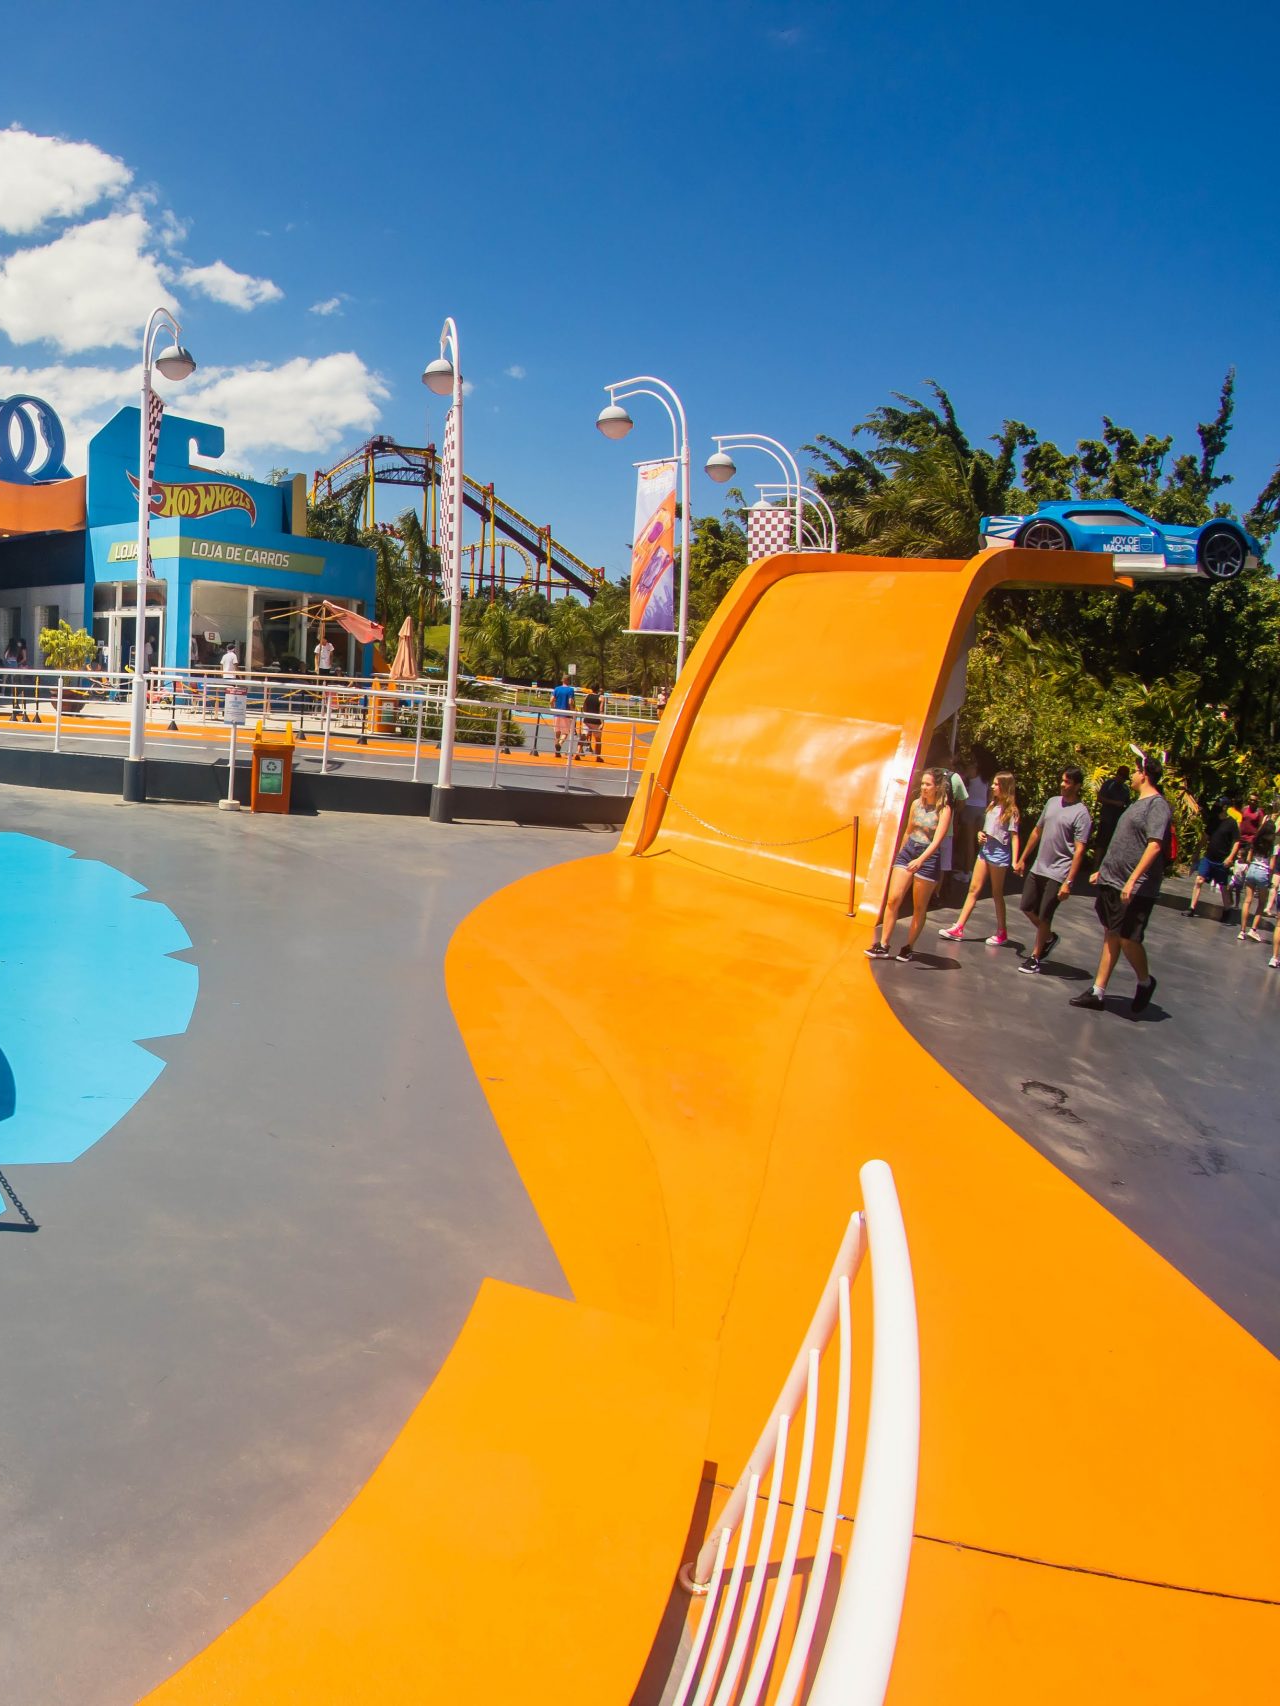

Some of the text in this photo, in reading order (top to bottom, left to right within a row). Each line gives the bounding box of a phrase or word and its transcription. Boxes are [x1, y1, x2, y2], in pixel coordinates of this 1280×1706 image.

[1110, 536, 1140, 545] JOY OF
[1103, 544, 1140, 553] MACHINE
[191, 541, 290, 568] LOJA DE CARROS
